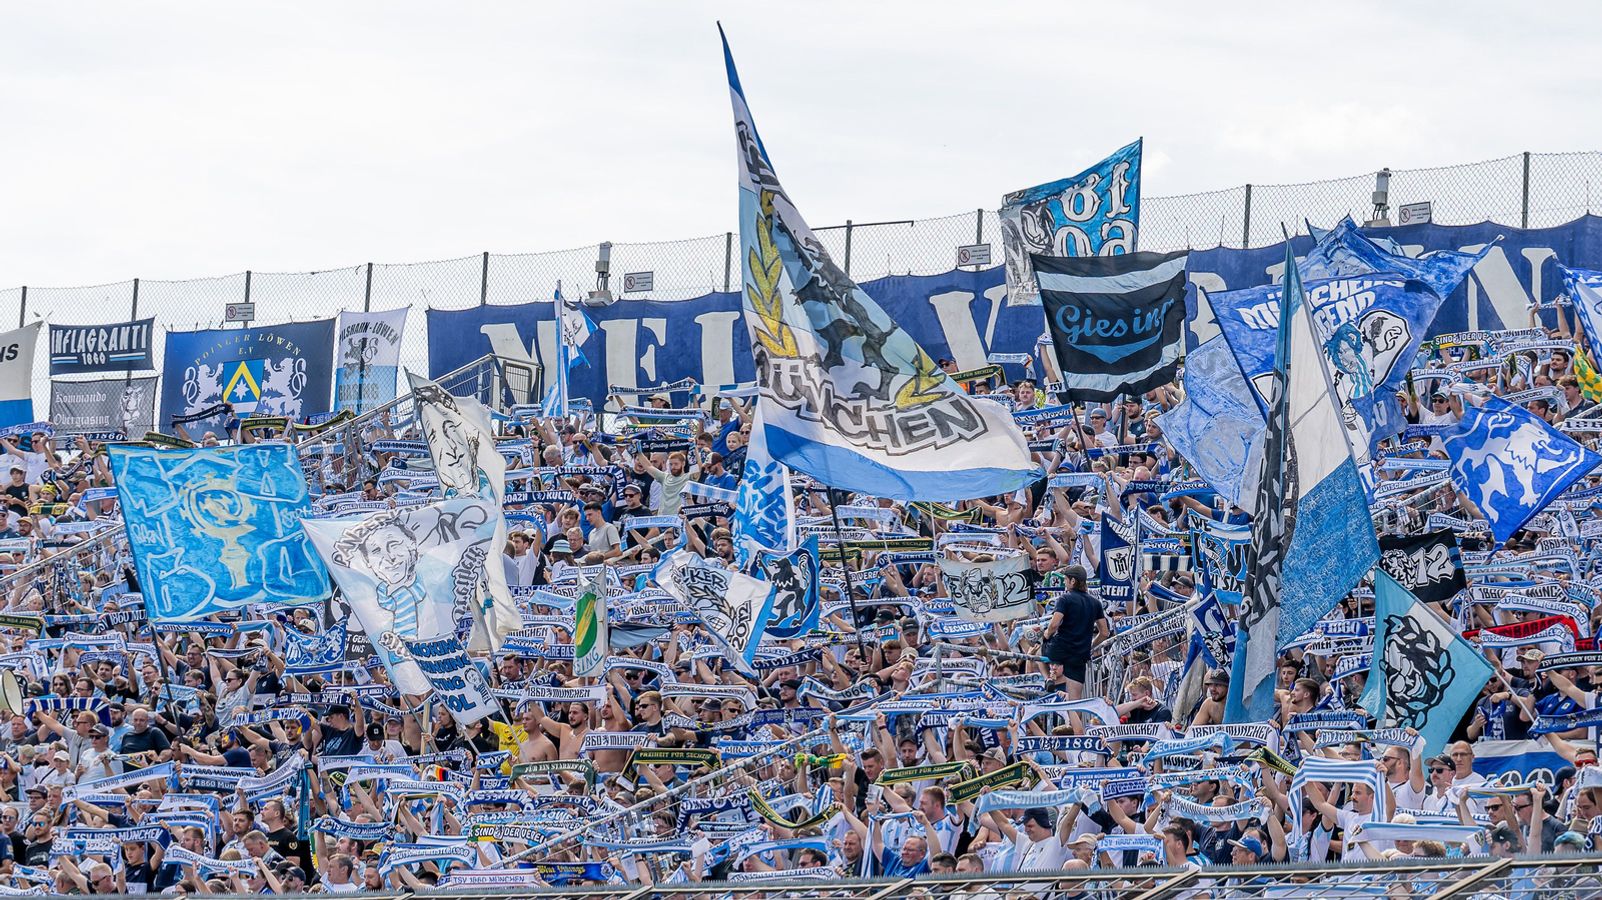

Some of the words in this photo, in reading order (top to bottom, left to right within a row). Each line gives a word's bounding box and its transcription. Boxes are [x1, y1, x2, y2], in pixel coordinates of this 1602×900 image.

[51, 324, 148, 354] INFLAGRANTI
[258, 332, 302, 357] LÖWEN
[1435, 333, 1453, 345] SIND
[81, 351, 105, 365] 1860
[54, 391, 107, 404] Kommando
[1041, 406, 1072, 419] Verein
[1411, 540, 1456, 583] 12
[995, 570, 1032, 605] 12
[1101, 585, 1130, 597] STEHT
[731, 600, 753, 652] 2012
[351, 643, 366, 652] UNS
[1553, 653, 1583, 664] MÜNCHEN
[322, 691, 344, 701] SPORT
[552, 686, 591, 698] MÜNCHEN
[1115, 722, 1160, 736] MÜNCHEN
[609, 734, 649, 747] MÜNCHEN
[1373, 729, 1417, 745] STADION
[1063, 738, 1104, 752] 1860
[1153, 739, 1187, 752] SECHZIG
[671, 750, 685, 759] FÜR
[890, 765, 918, 777] FREIHEIT
[919, 764, 932, 773] FÜR
[333, 822, 346, 834] TSV
[475, 826, 493, 838] SIND
[504, 826, 520, 838] DER
[118, 828, 164, 843] MÜNCHEN
[453, 876, 467, 884] TSV
[469, 875, 486, 884] 1860
[488, 875, 525, 883] MÜNCHEN
